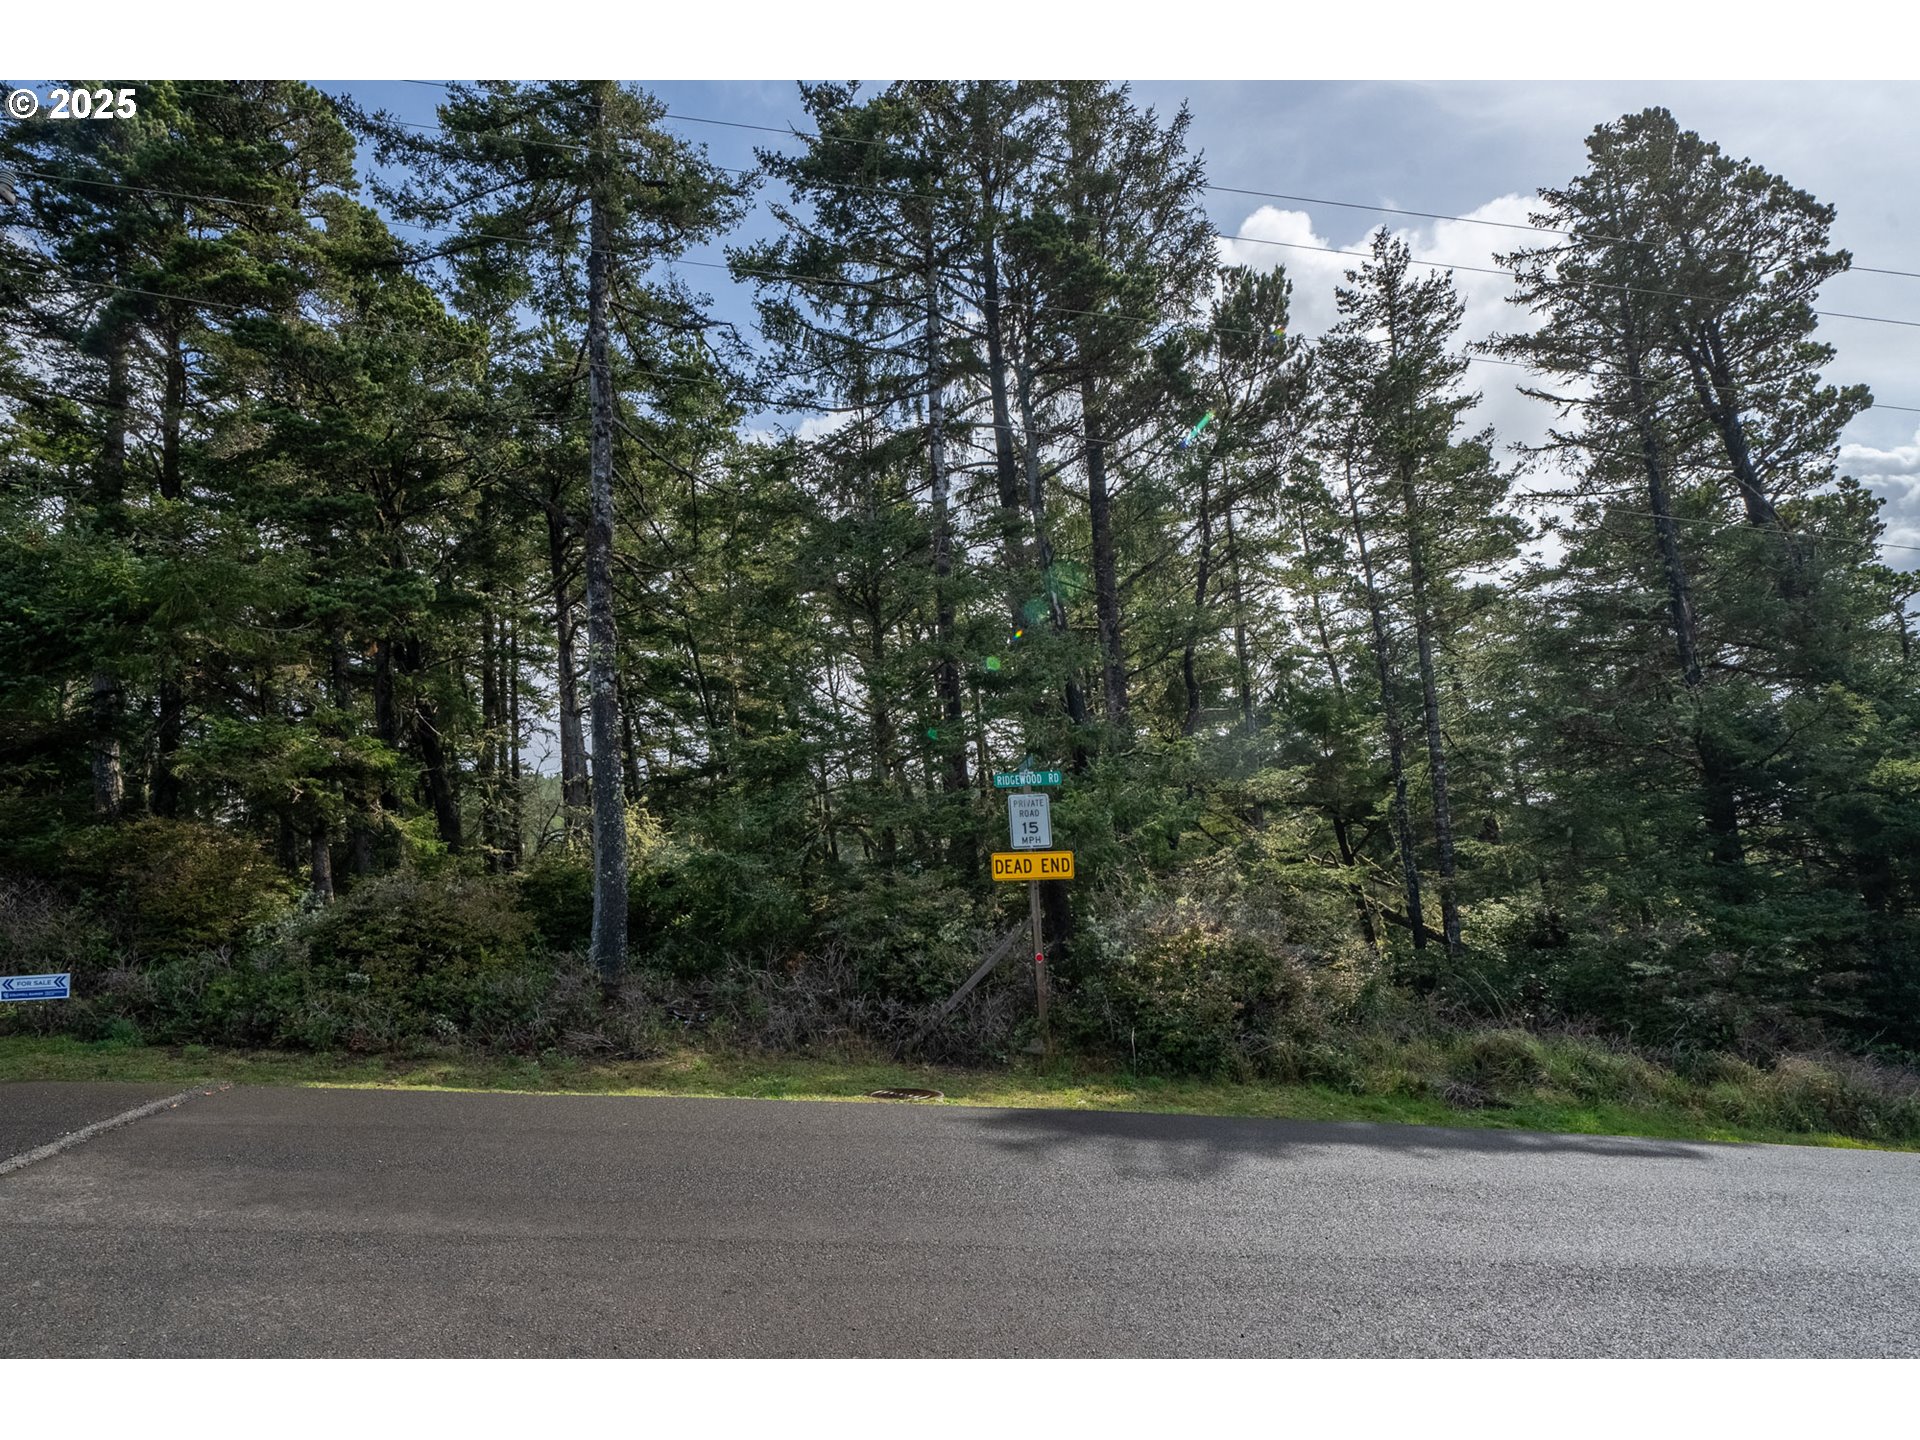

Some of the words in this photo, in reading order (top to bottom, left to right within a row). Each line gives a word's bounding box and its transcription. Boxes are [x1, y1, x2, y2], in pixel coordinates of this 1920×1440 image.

[996, 774, 1042, 786] RIDGEWOOD
[1048, 773, 1060, 783] RD
[1013, 799, 1045, 808] PRIVATE
[1019, 809, 1040, 818] ROAD
[1022, 821, 1039, 834] 15
[1021, 836, 1042, 845] MPH
[995, 858, 1033, 874] DEAD
[1041, 857, 1070, 873] END
